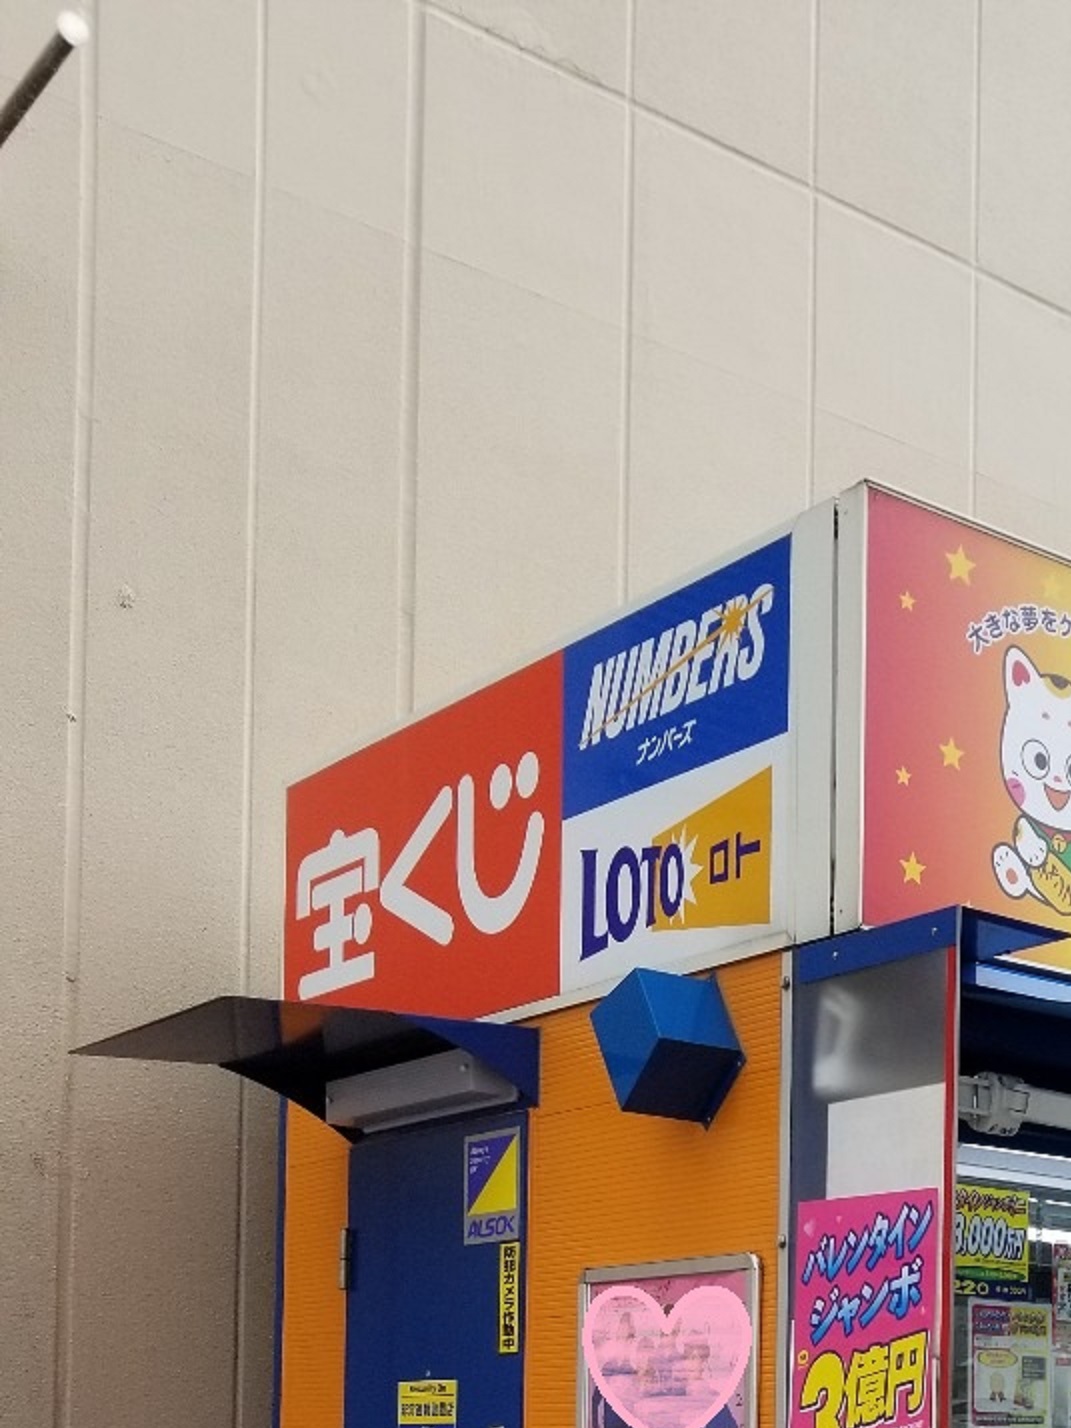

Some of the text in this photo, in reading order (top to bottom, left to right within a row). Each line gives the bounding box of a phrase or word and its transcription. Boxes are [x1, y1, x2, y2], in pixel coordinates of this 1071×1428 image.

[579, 583, 774, 751] NUMBERS
[636, 719, 697, 765] ナンバーズ
[296, 751, 544, 1001] 宝くじ
[579, 832, 761, 962] LOTO ロト
[467, 1215, 515, 1238] ALSOK
[802, 1200, 933, 1284] バレンタイン
[810, 1257, 923, 1345] ジャンボ
